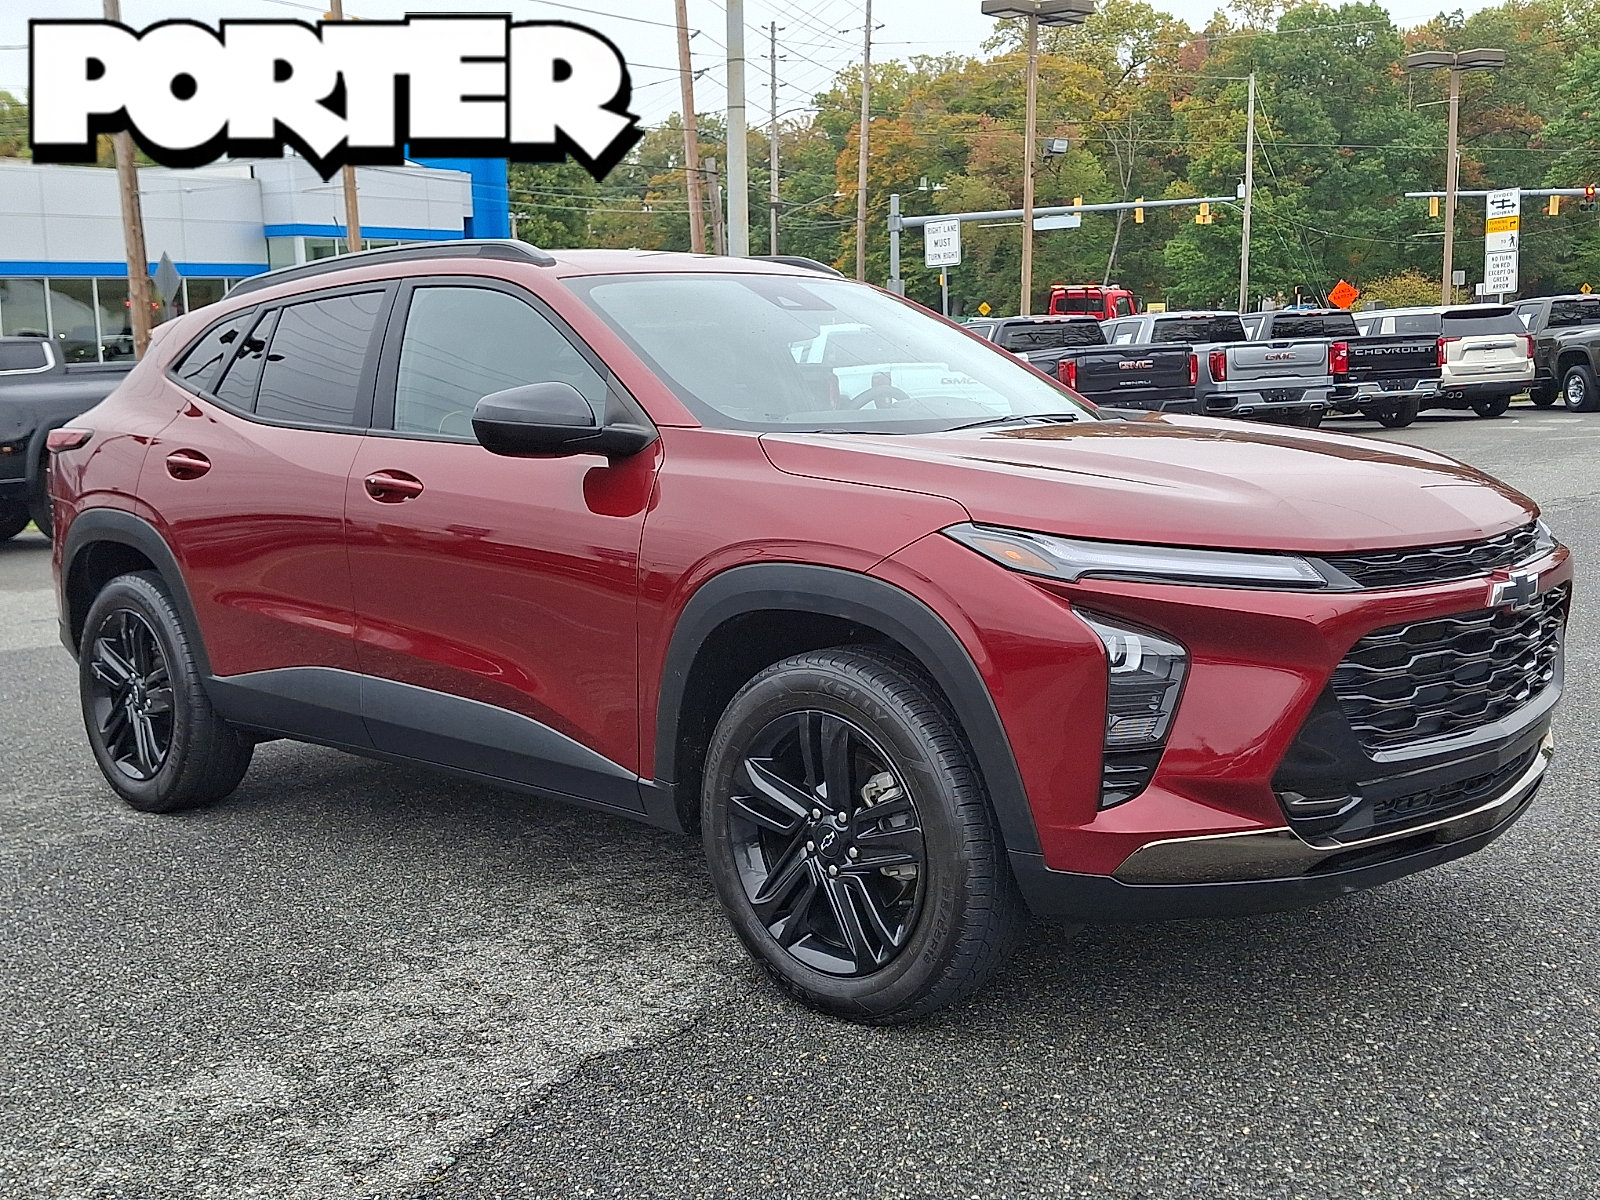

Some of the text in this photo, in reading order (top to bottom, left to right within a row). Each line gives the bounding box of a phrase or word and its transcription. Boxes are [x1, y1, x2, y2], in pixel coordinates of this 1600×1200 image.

[927, 224, 957, 234] RIGHT LANE
[934, 238, 951, 247] MUST
[927, 251, 958, 261] TURN RIGHT
[1264, 351, 1297, 361] GMC
[1354, 346, 1434, 356] CHEVROLET
[1118, 360, 1154, 370] GMC
[941, 377, 978, 385] GMC
[817, 679, 889, 722] KELLY
